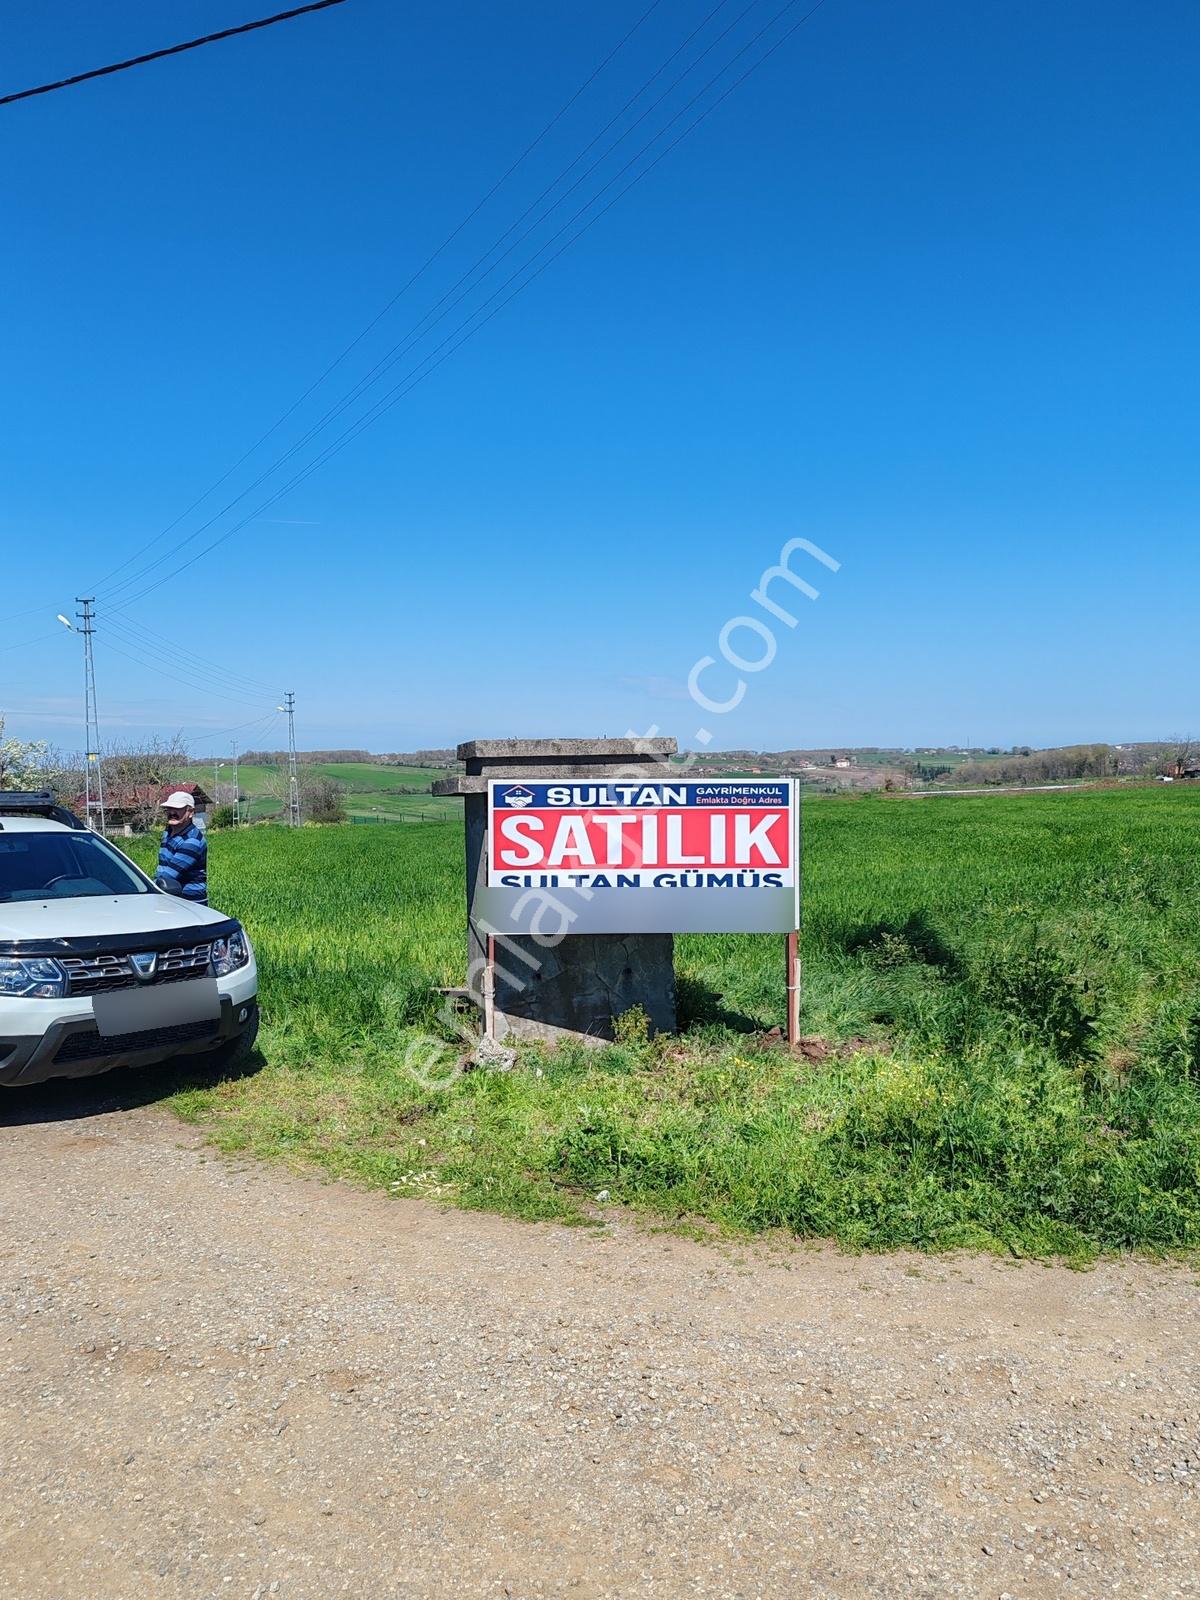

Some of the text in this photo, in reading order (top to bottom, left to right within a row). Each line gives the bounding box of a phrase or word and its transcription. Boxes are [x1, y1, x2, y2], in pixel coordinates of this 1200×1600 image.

[546, 787, 687, 806] SULTAN
[696, 785, 783, 795] GAYRİMENKUL
[696, 796, 782, 806] Emlakta Doğru Adres
[500, 814, 783, 868] SATILIK
